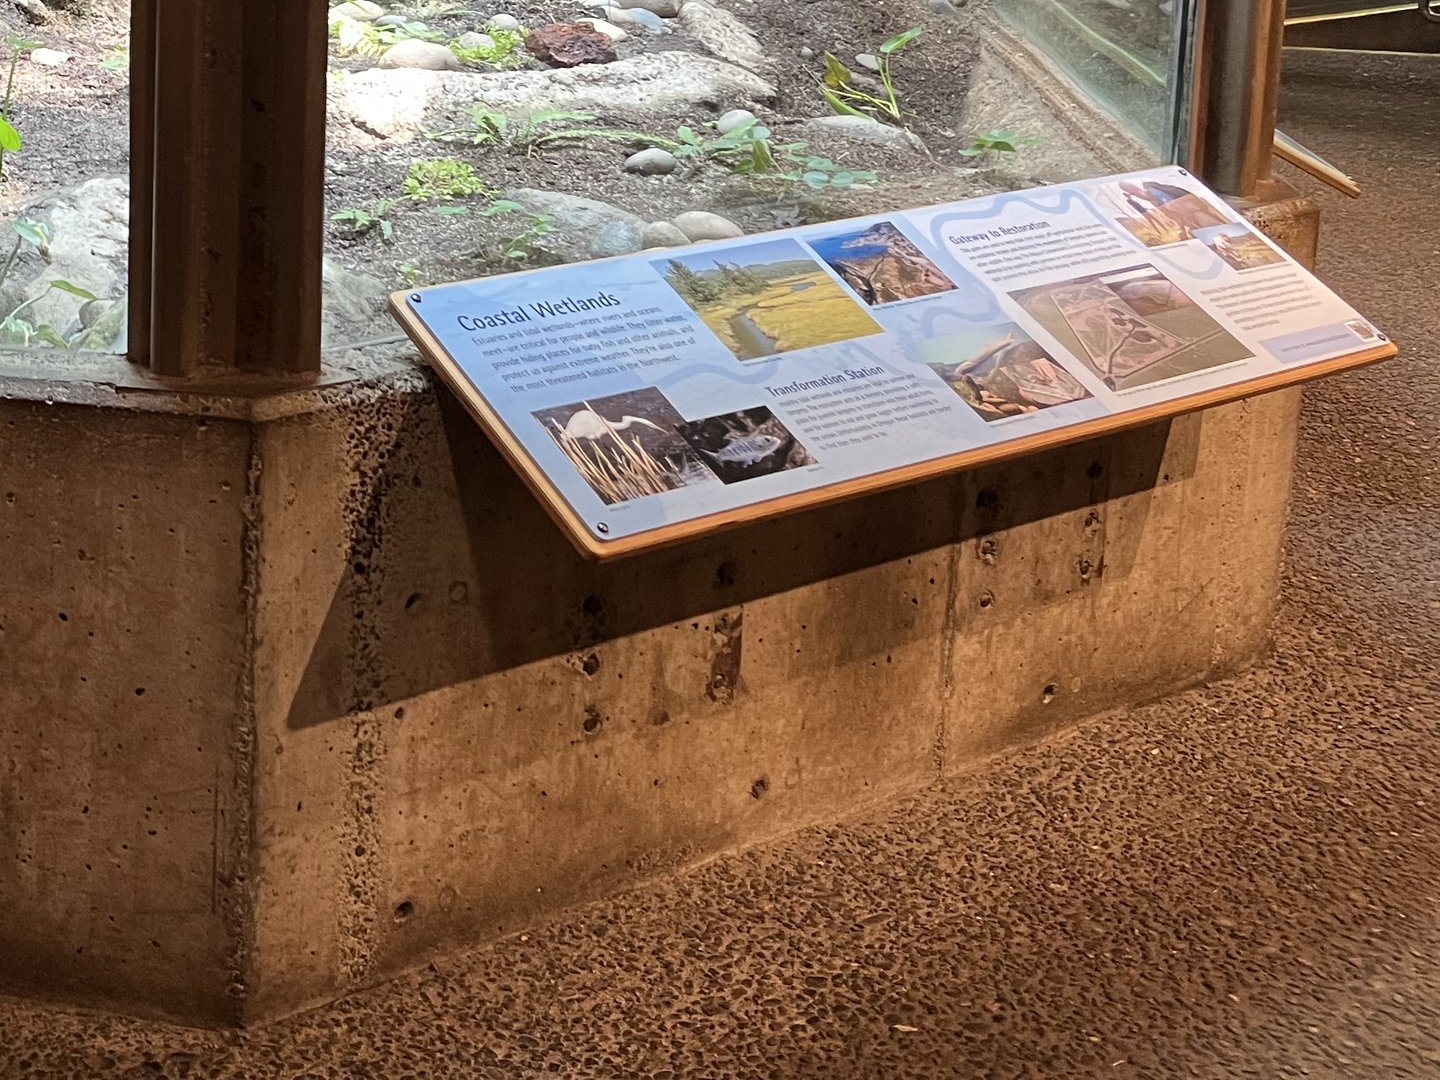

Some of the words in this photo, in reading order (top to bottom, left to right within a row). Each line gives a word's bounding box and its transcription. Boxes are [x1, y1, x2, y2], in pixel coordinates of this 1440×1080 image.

[948, 231, 990, 246] Gateway
[989, 230, 1000, 239] to
[998, 220, 1051, 236] Restoration
[457, 305, 531, 332] Coastal
[528, 291, 622, 319] Wetlands
[764, 374, 847, 397] Transformation
[844, 365, 885, 381] Station
